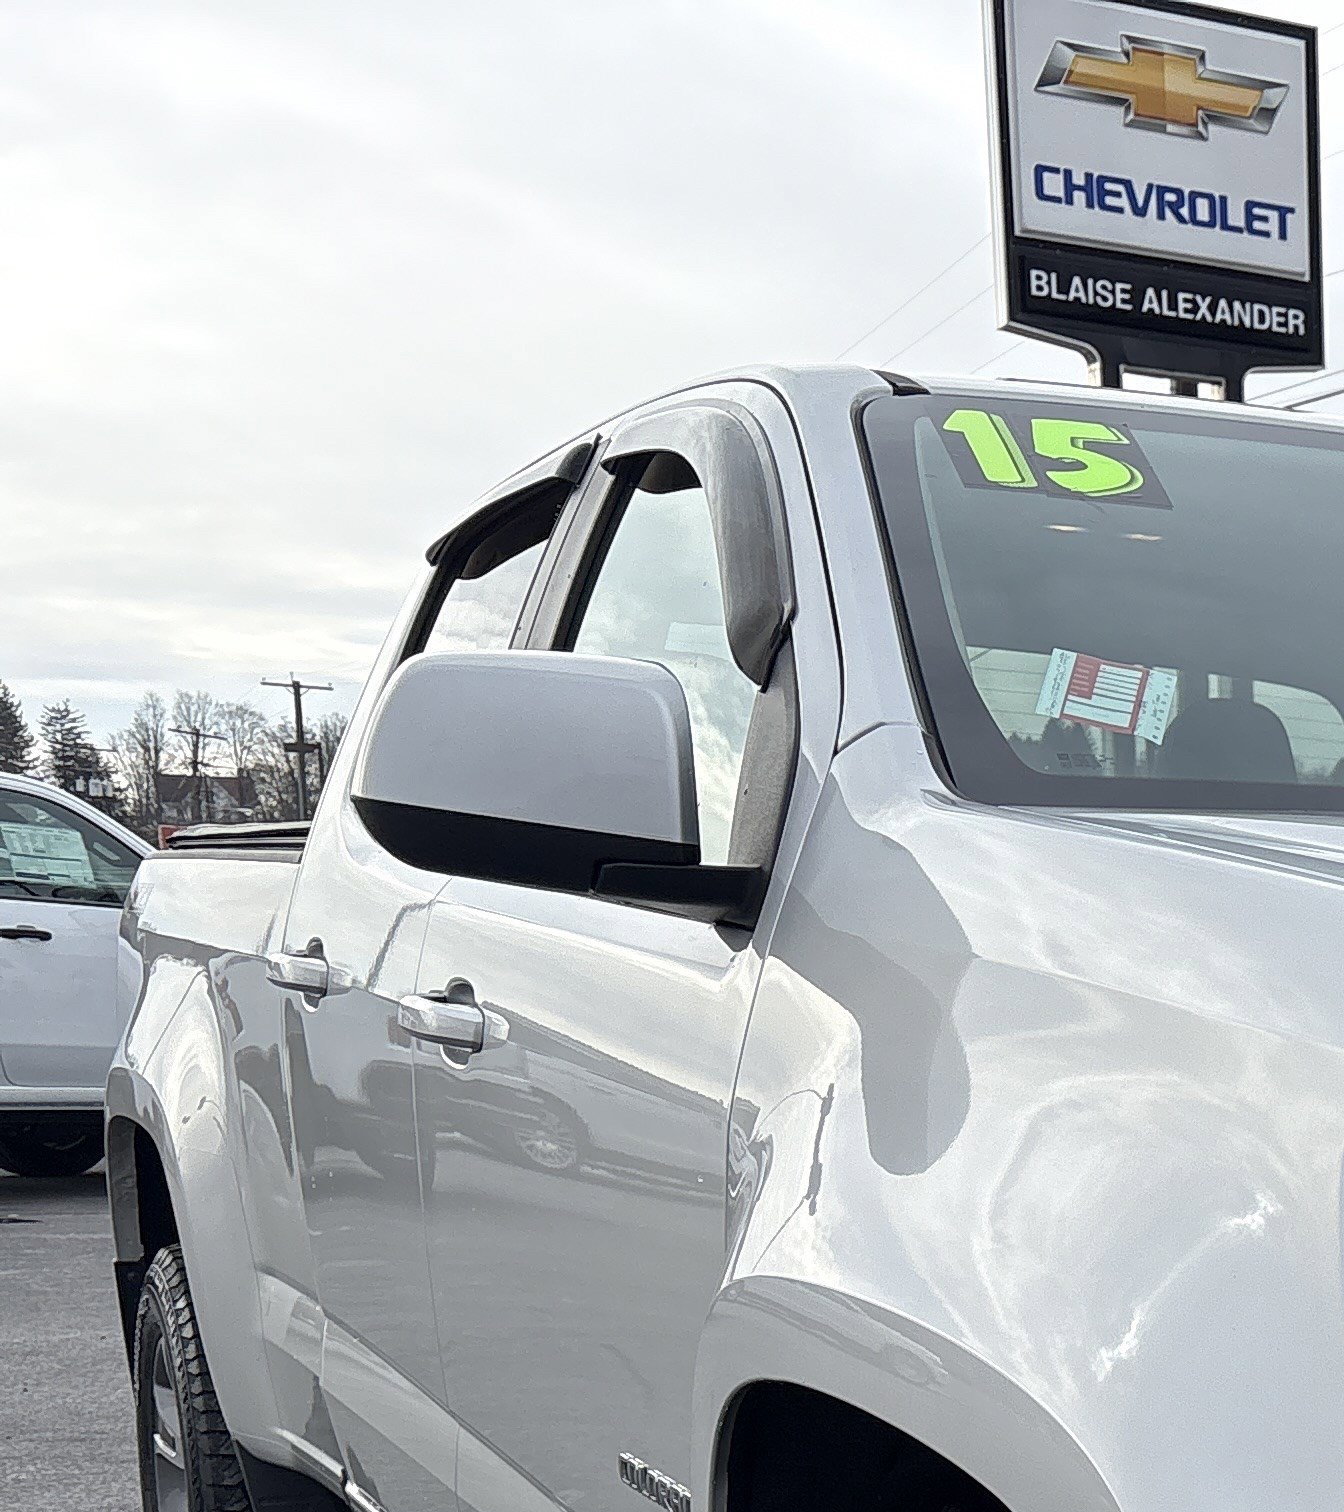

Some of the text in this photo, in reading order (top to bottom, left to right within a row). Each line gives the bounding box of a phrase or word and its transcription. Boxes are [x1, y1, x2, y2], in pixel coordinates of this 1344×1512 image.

[1033, 163, 1296, 242] CHEVROLET
[1029, 268, 1306, 337] BLAISE ALEXANDER
[943, 409, 1145, 497] 15
